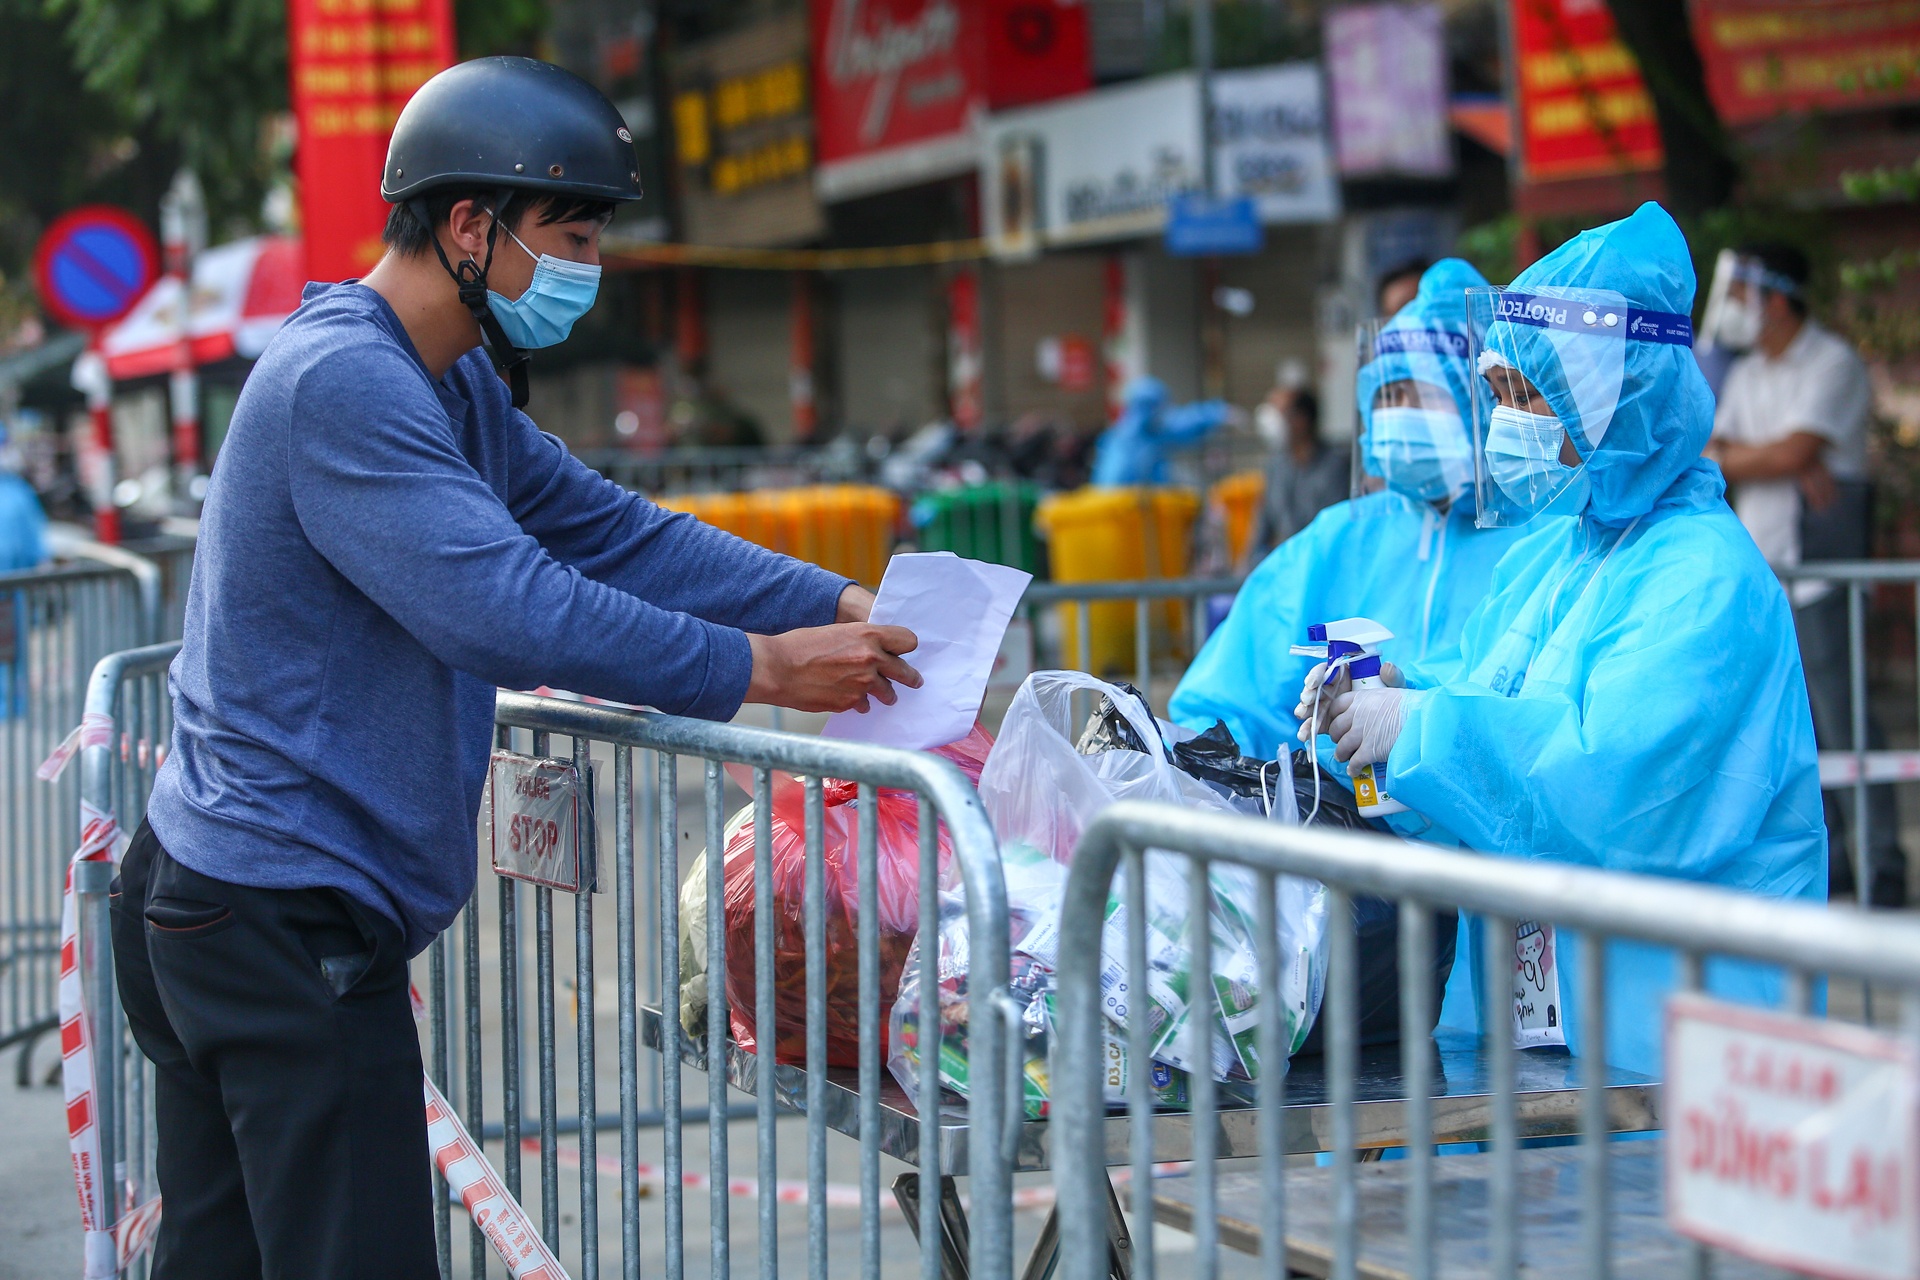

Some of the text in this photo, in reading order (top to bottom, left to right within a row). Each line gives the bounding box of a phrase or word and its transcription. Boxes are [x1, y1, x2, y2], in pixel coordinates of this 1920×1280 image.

[510, 812, 558, 859] STOP
[485, 1220, 520, 1271] NOT ALLOWED AREA
